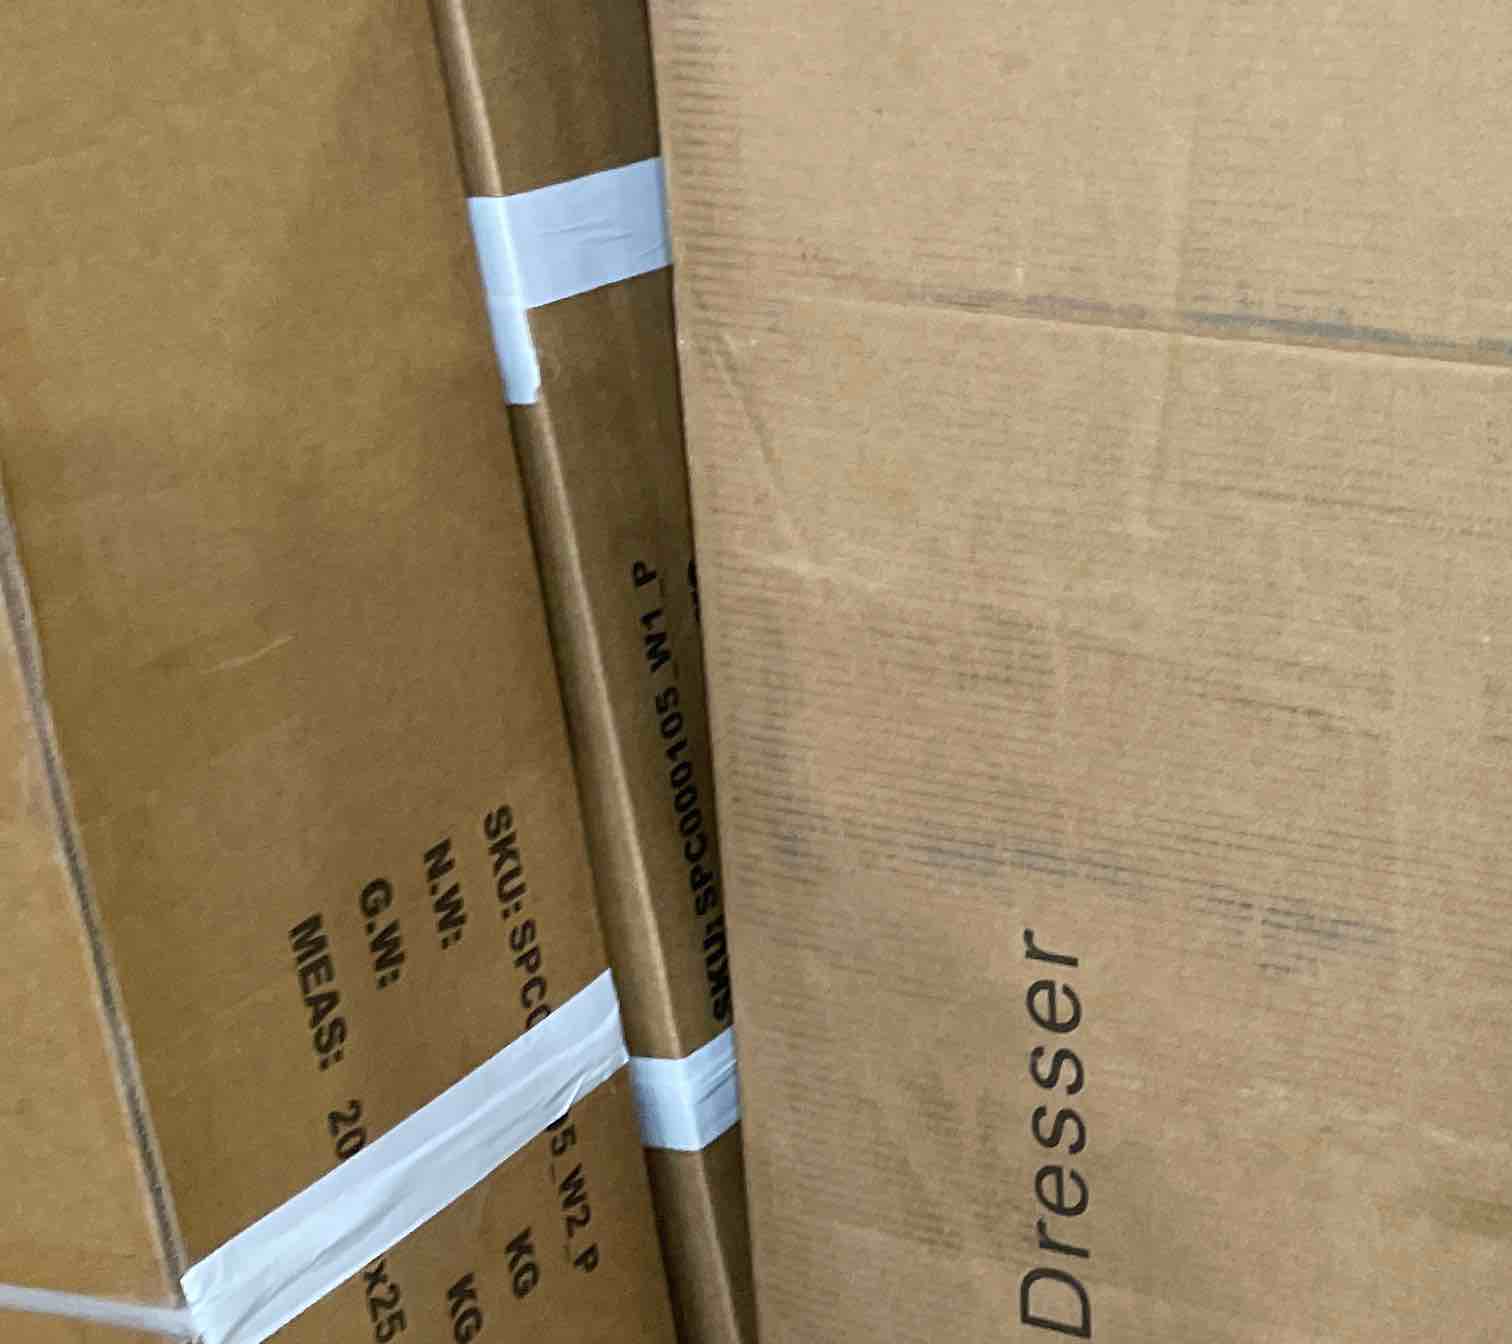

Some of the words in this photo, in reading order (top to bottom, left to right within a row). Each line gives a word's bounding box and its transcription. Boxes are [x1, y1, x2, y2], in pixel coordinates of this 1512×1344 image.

[359, 878, 404, 989] G.W:
[483, 804, 526, 919] SKU:
[289, 914, 346, 1072] MEAS:
[423, 837, 467, 949] N.W:
[504, 1226, 540, 1301] KG
[1022, 929, 1092, 1339] Dresser
